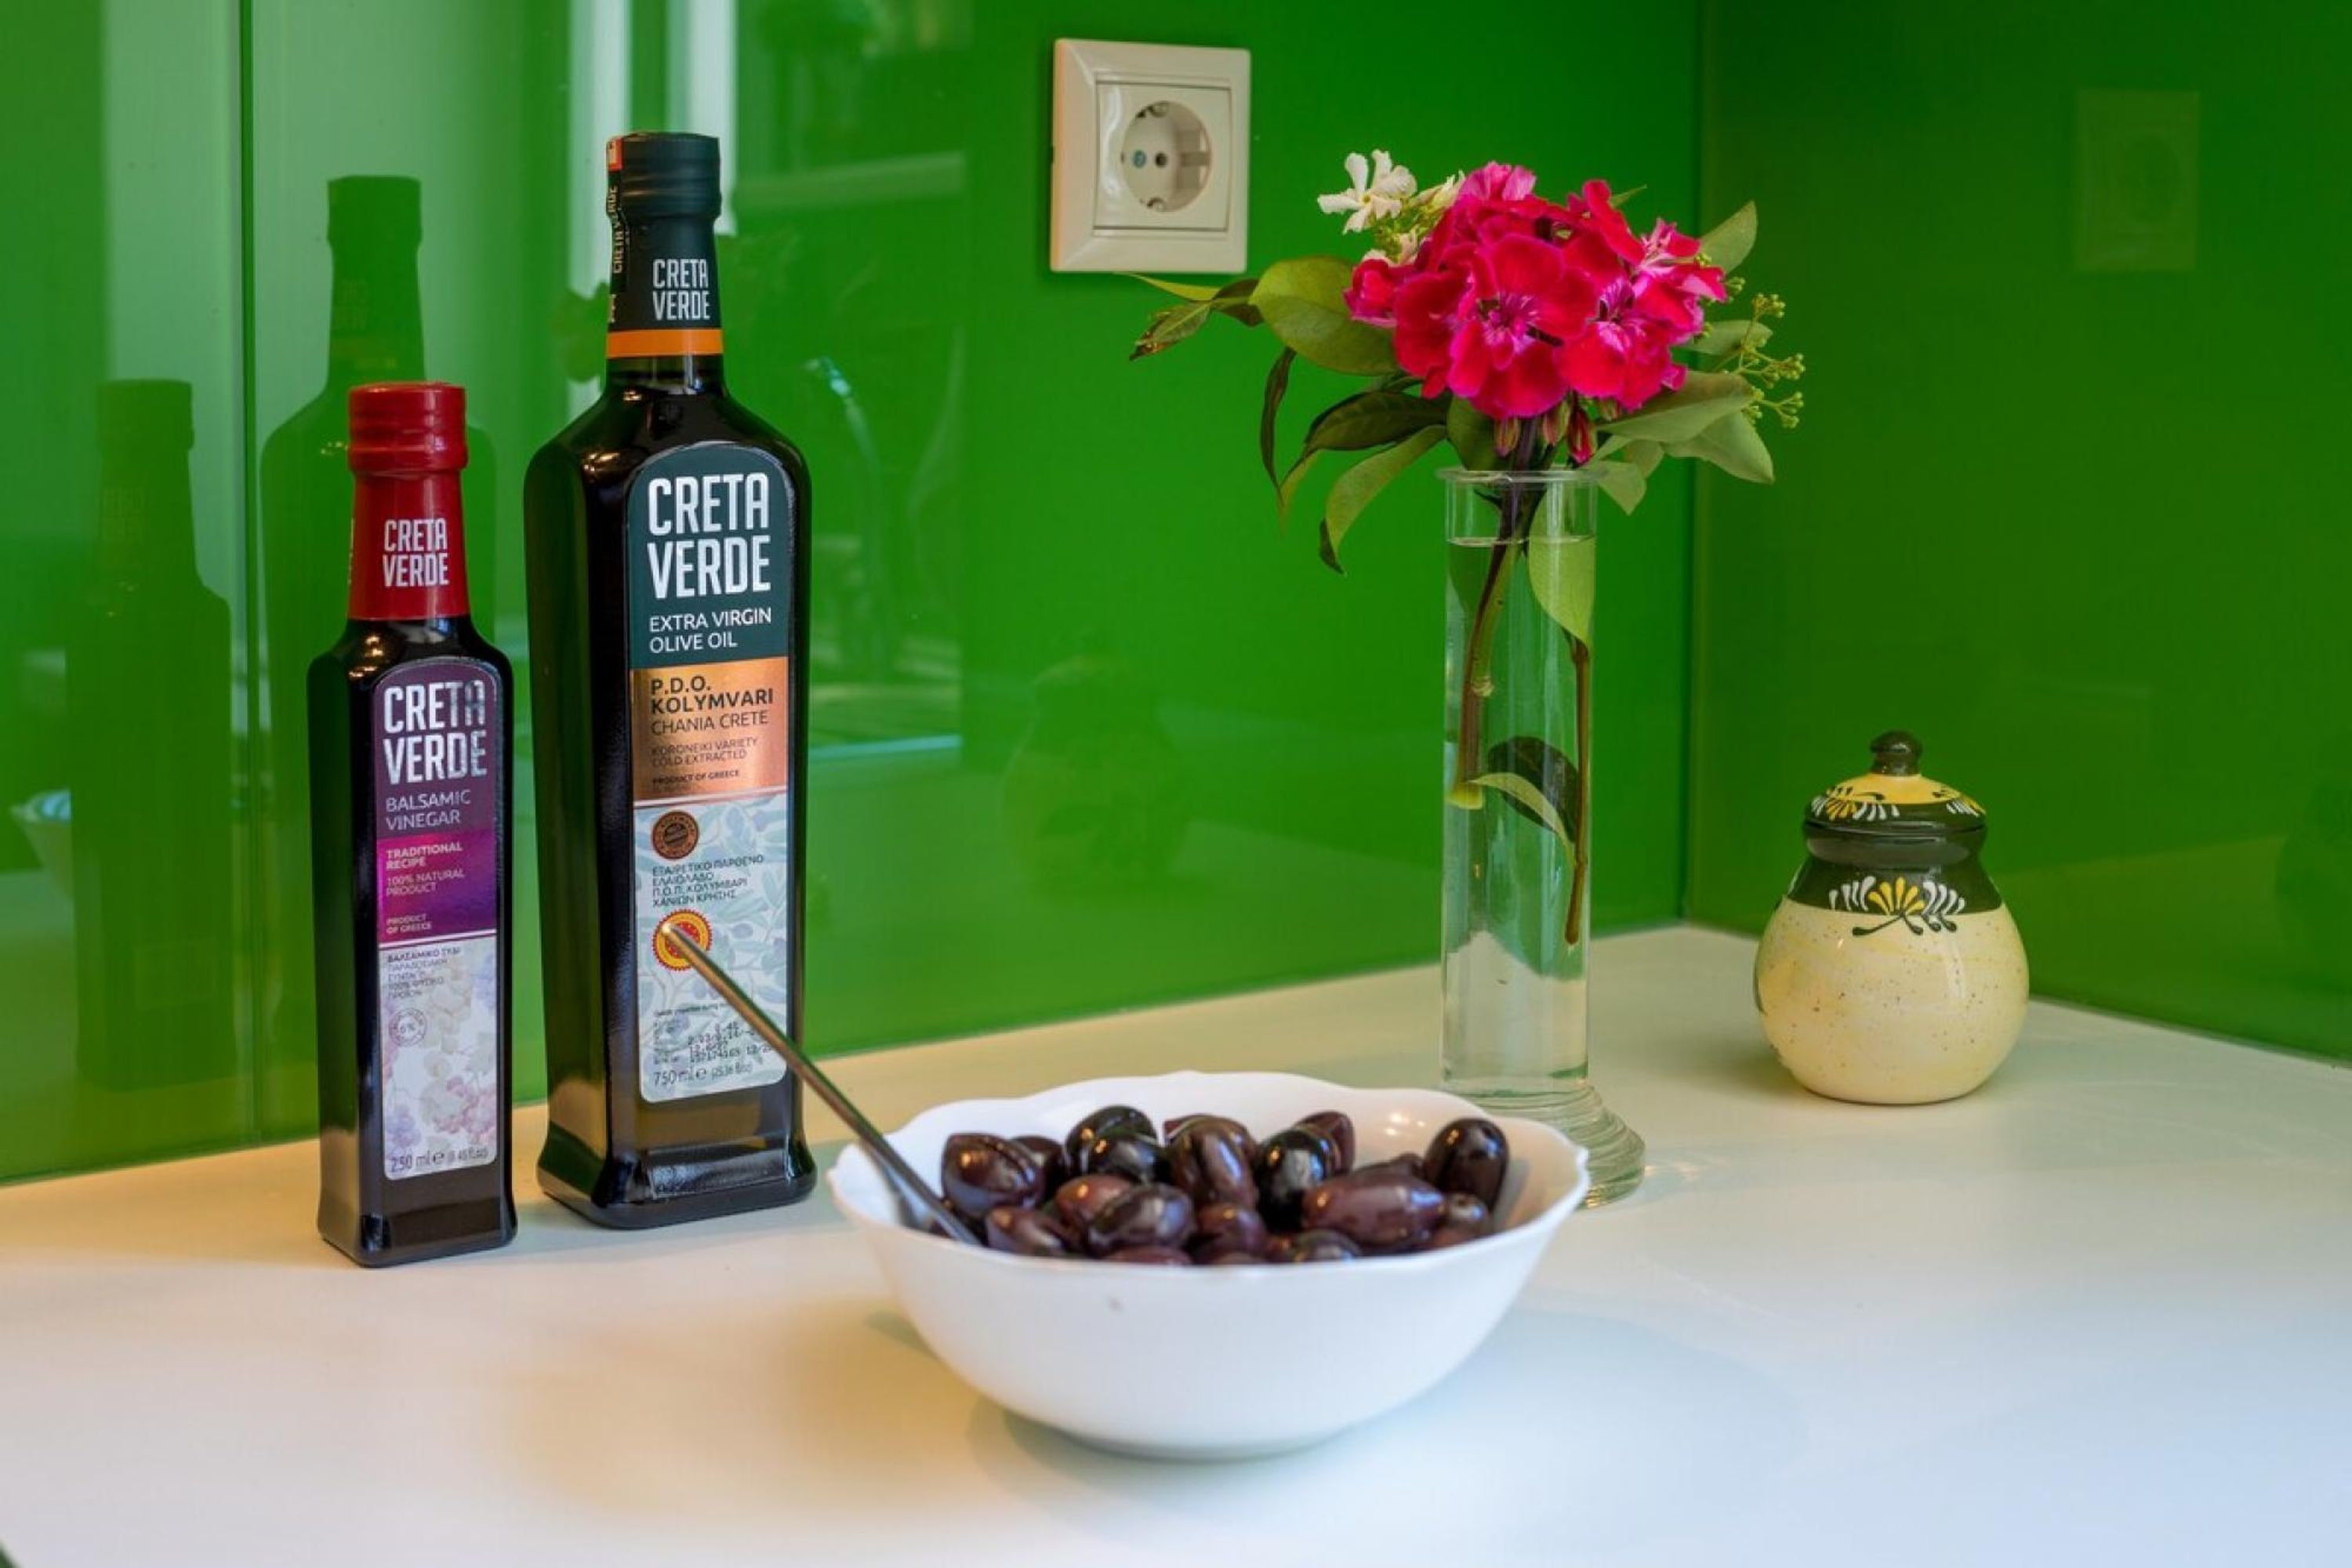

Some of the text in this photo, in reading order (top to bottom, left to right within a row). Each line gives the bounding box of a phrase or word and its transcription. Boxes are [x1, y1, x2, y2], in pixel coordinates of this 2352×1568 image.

[653, 259, 709, 289] CRETA
[652, 290, 711, 321] VERDE
[648, 472, 770, 536] CRETA
[384, 517, 448, 552] CRETA
[382, 553, 450, 587] VERDE
[647, 535, 771, 600] VERDE
[649, 607, 772, 633] EXTRA VIRGIN
[649, 632, 739, 654] OLIVE OIL
[650, 675, 711, 695] P.D.O.
[383, 680, 486, 734] CRETA
[651, 688, 775, 715] KOLYMVARI
[650, 710, 770, 735] CHANIA CRETE
[382, 730, 487, 785] VERDE
[386, 789, 471, 813] BALSAMIC
[385, 809, 461, 830] VINEGAR
[386, 841, 463, 859] TRADITIONAL
[387, 856, 426, 869] RECIPE
[387, 868, 465, 887] 100% NATURAL
[387, 882, 437, 897] PRODUCT
